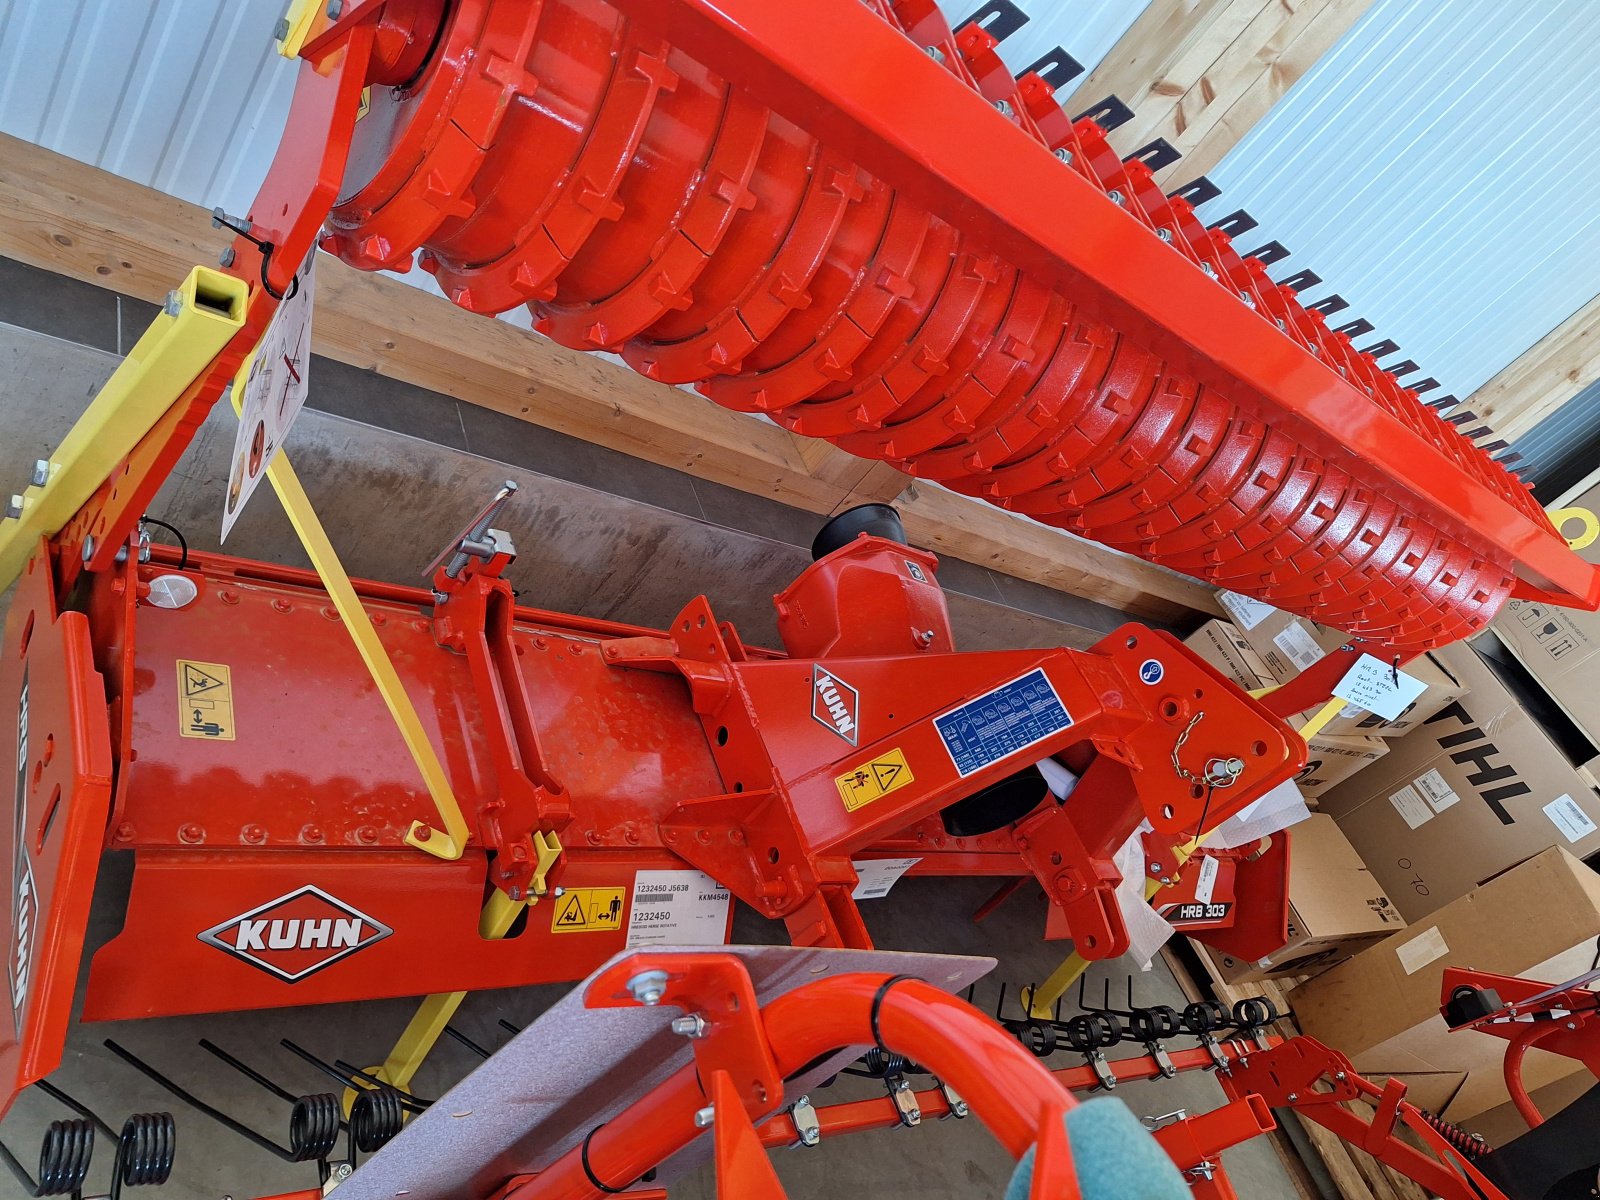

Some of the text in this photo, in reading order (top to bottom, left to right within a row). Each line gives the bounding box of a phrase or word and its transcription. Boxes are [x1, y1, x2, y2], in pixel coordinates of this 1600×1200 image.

[815, 674, 855, 735] KUHN
[18, 684, 29, 772] HRB
[637, 884, 666, 892] 1232450
[633, 911, 670, 921] 1232450
[1180, 904, 1225, 918] HRB 303
[13, 864, 33, 1010] KUHN
[233, 918, 364, 951] KUHN
